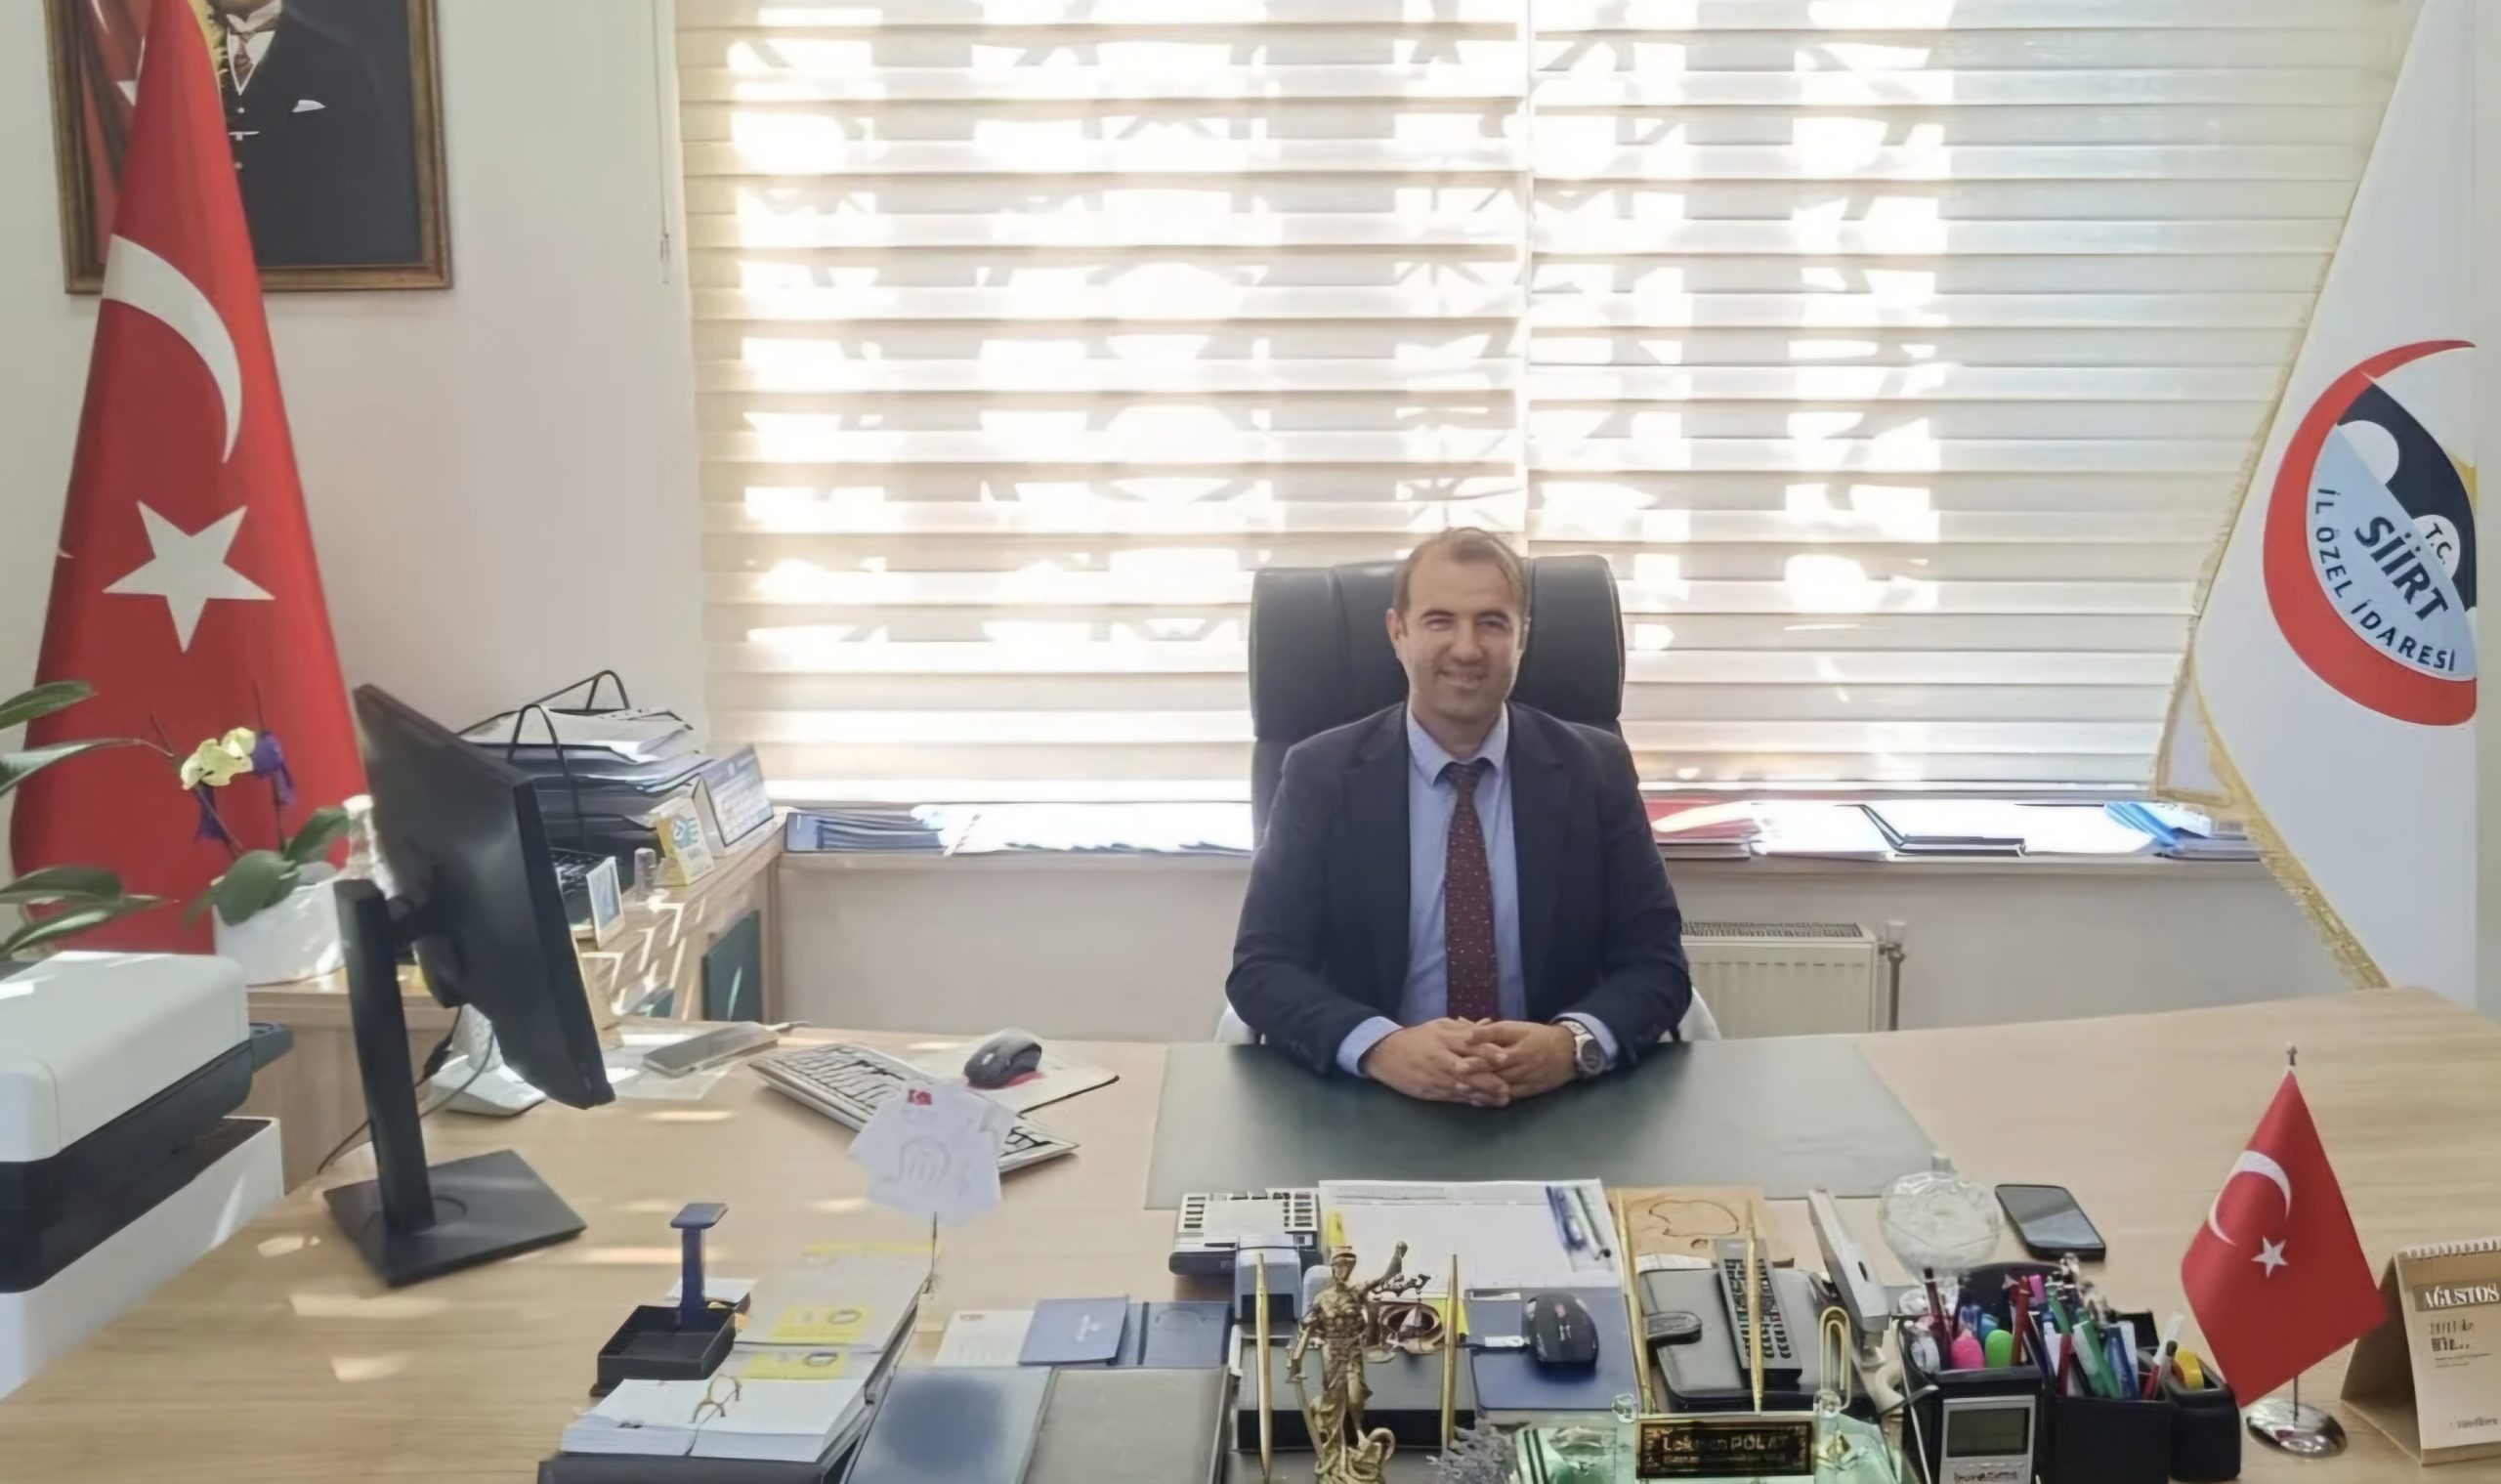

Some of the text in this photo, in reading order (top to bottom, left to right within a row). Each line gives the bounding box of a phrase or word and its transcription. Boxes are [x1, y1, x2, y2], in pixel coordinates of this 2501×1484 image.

[2315, 488, 2456, 672] İL ÖZEL İDARESİ
[2353, 516, 2449, 621] SİİRT
[2425, 523, 2452, 565] T.C.
